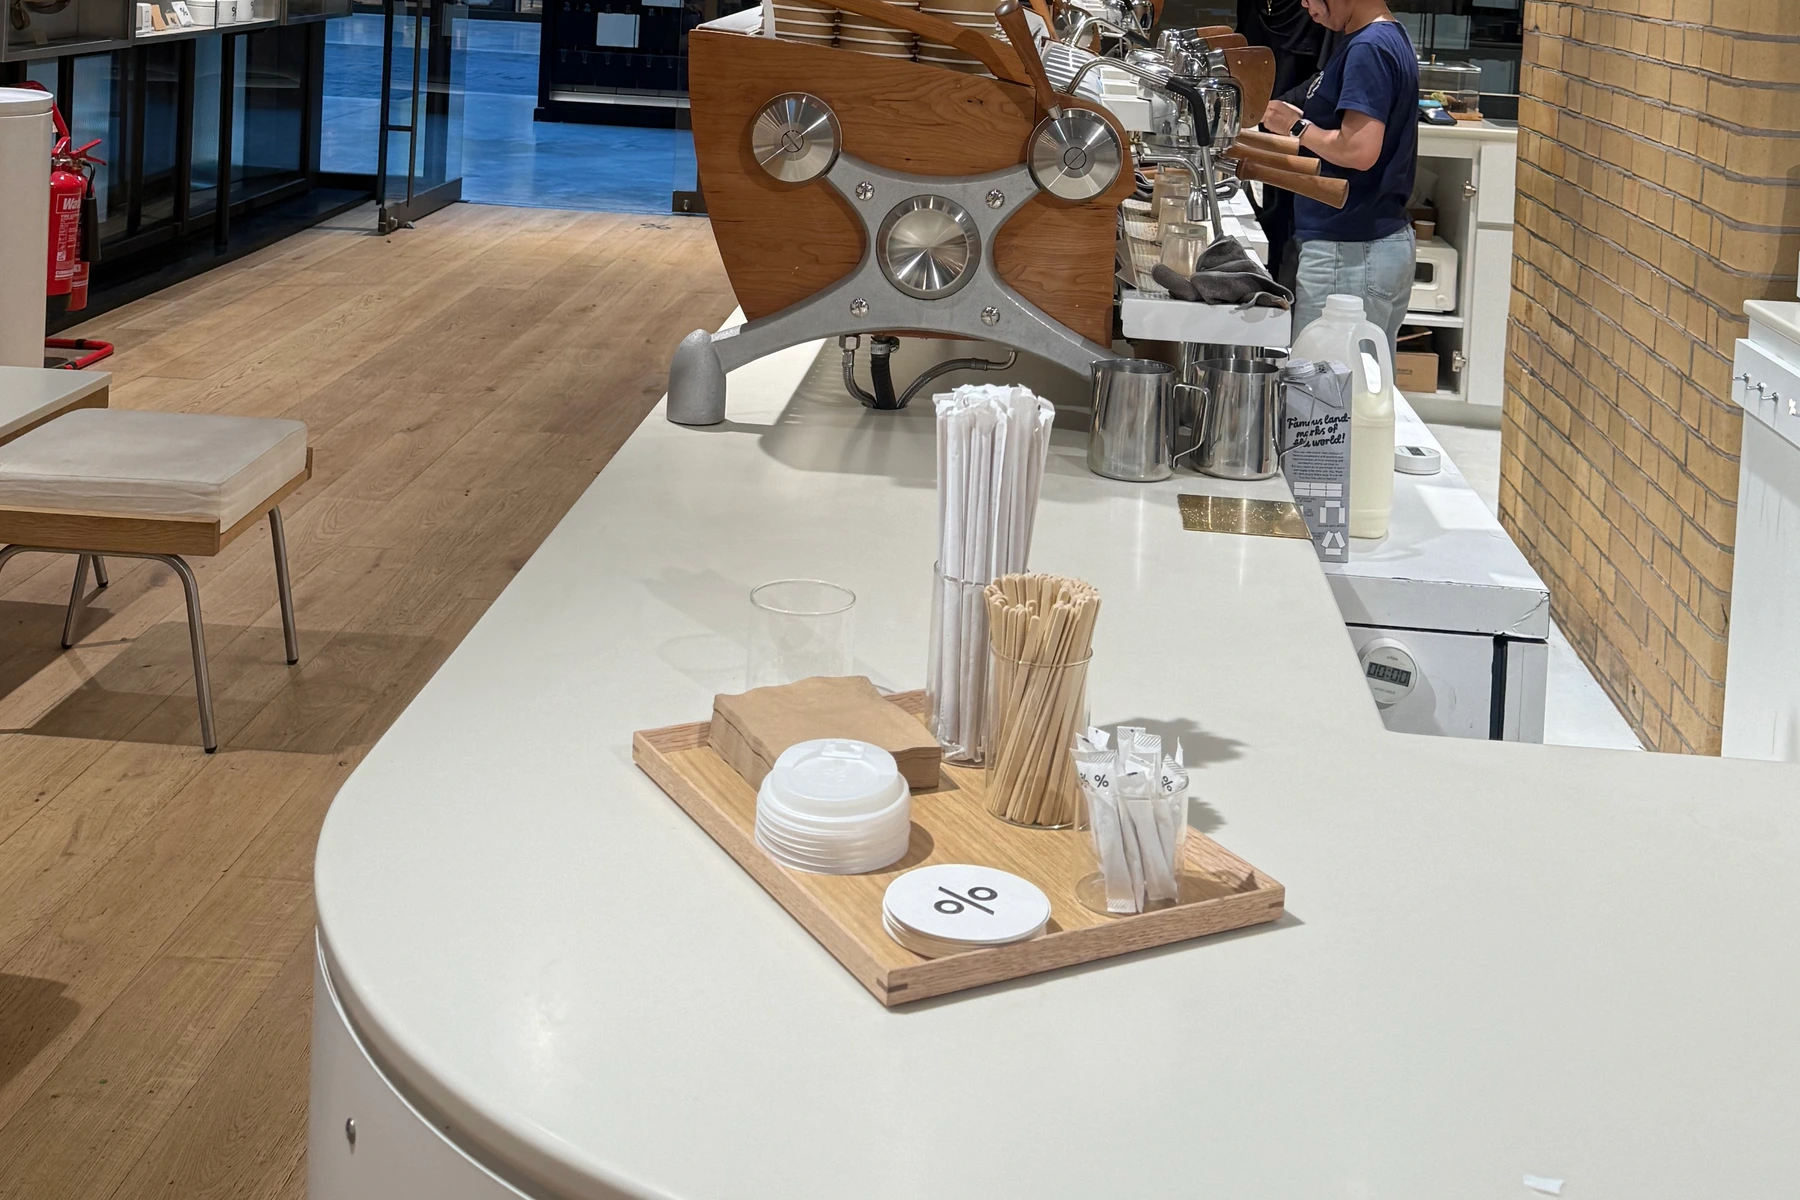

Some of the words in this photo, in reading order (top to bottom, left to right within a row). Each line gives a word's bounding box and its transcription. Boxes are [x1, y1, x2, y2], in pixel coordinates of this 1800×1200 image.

[63, 197, 81, 210] Wat
[1324, 412, 1351, 425] land-
[1327, 423, 1339, 434] of
[1312, 432, 1346, 447] world!
[1367, 662, 1409, 685] 00:00
